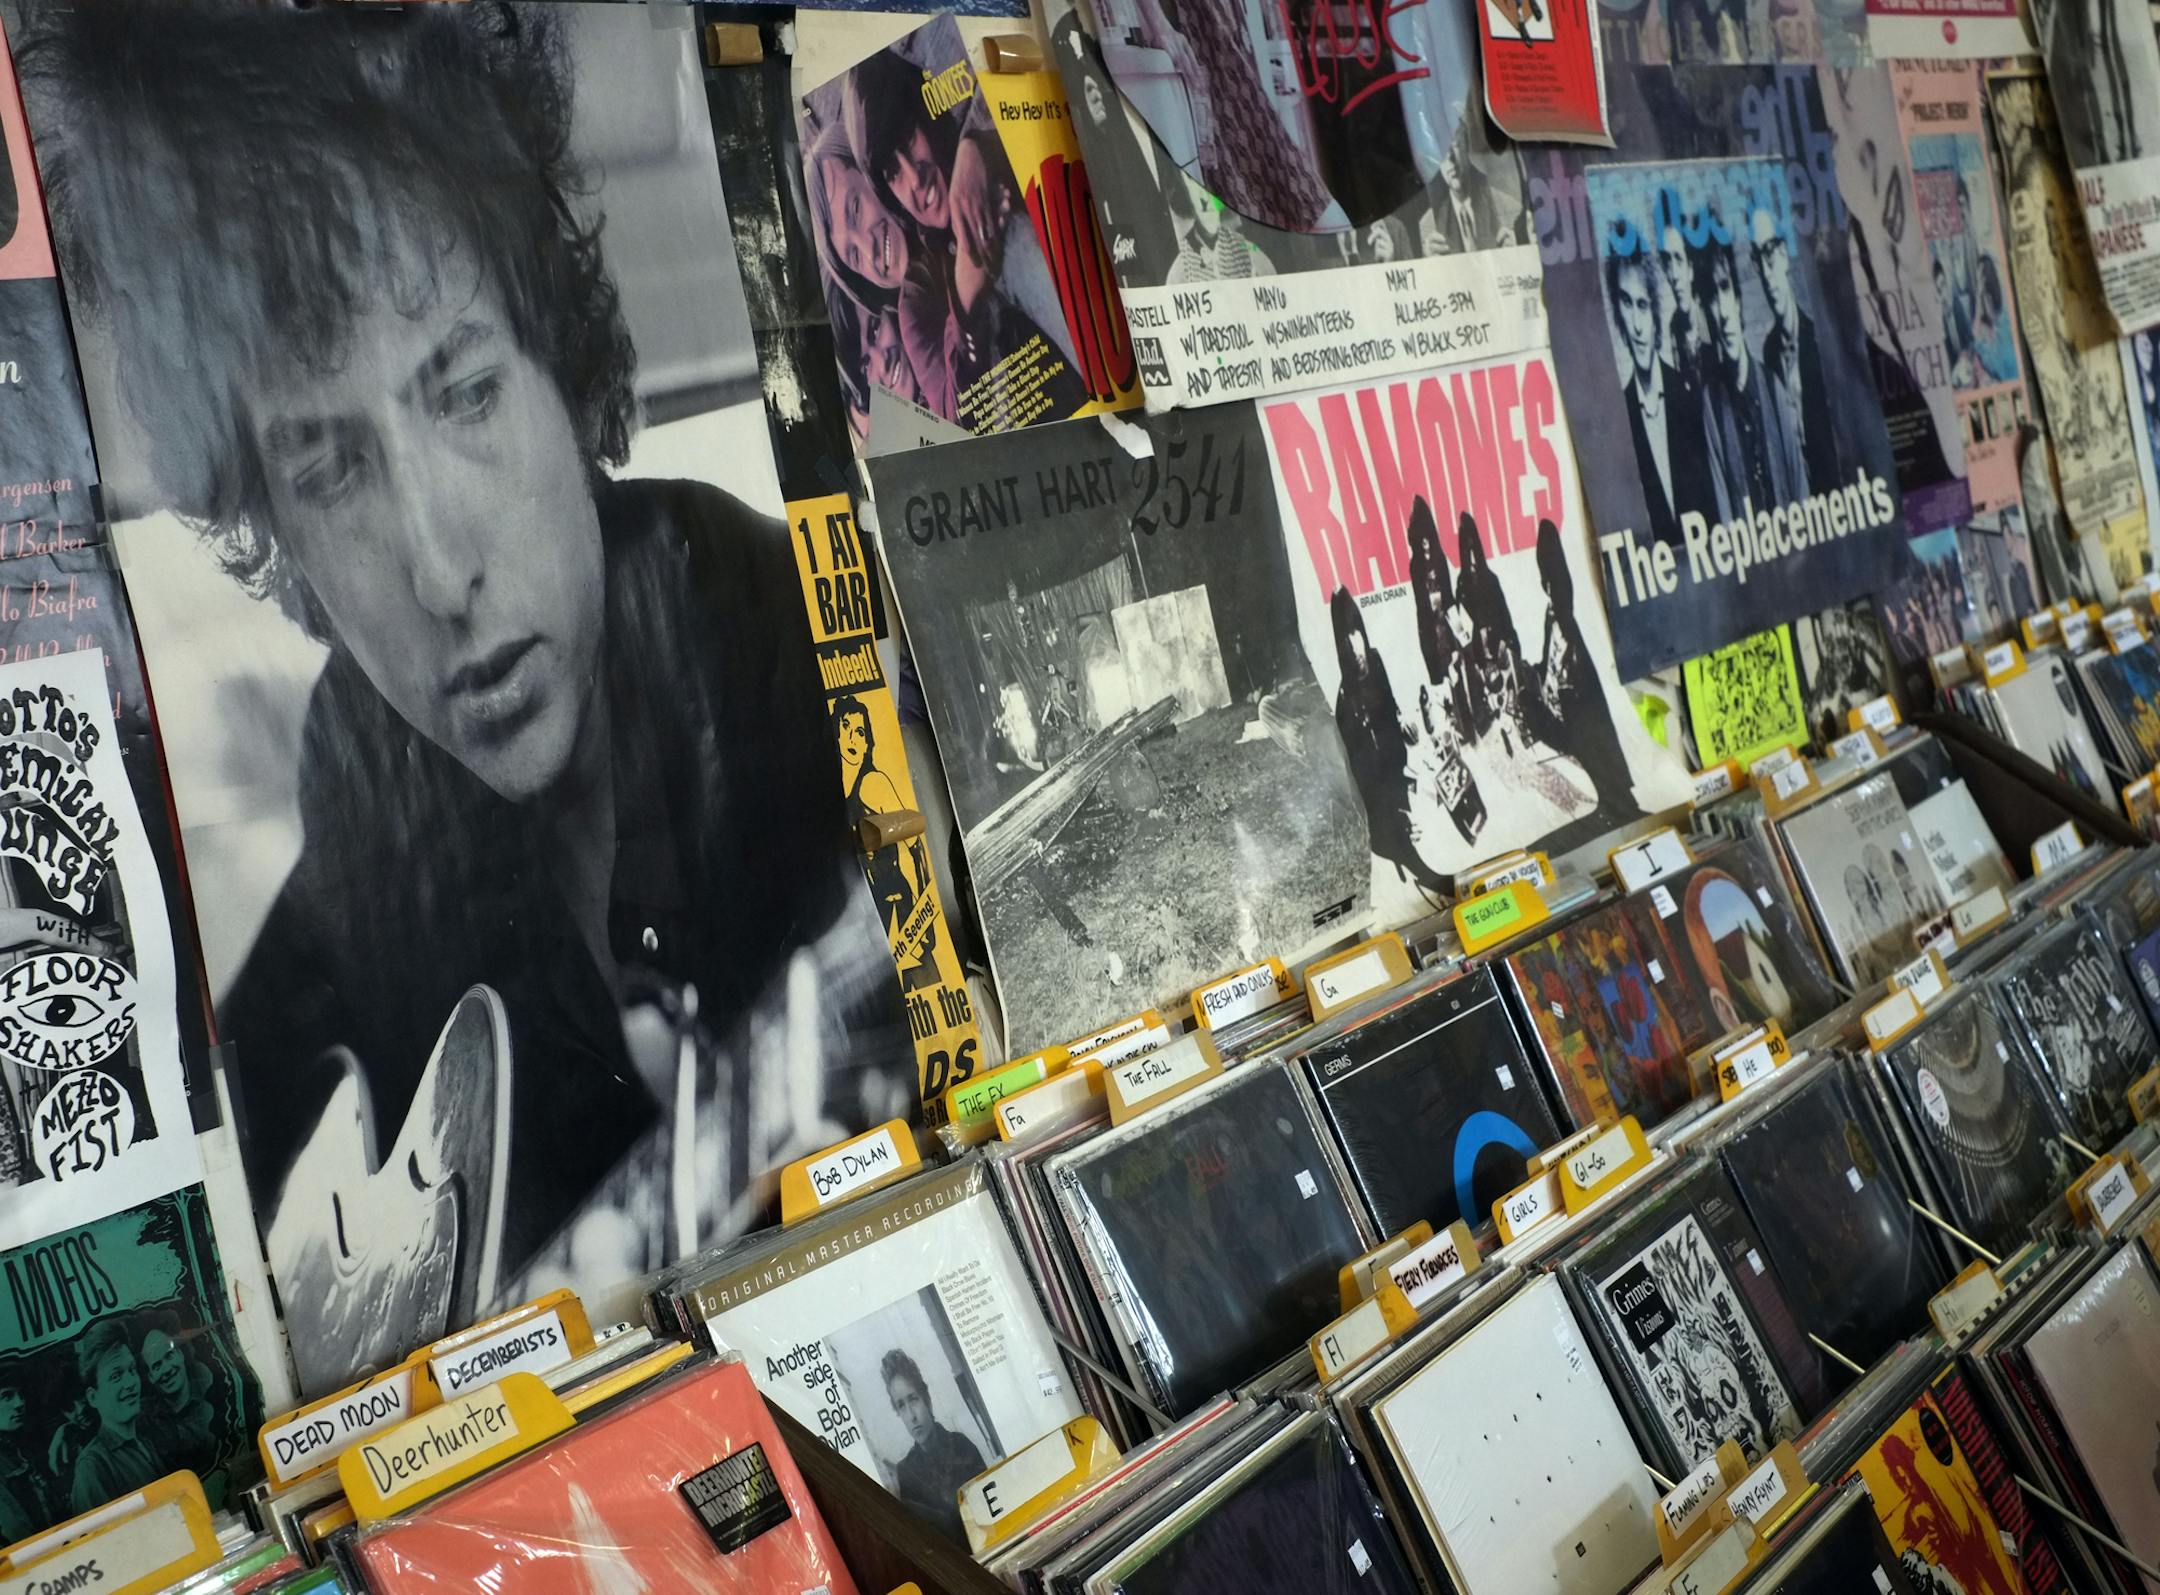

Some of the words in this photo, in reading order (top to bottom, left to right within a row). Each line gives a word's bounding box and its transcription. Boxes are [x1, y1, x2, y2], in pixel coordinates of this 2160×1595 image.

[1000, 101, 1019, 121] Hey
[1023, 101, 1043, 121] Hey
[1187, 368, 1213, 399] AND
[1271, 357, 1292, 383] AND
[914, 407, 940, 423] STEREO
[904, 476, 1022, 547] GRANT
[1036, 457, 1118, 518] HART
[1131, 433, 1246, 536] 2541
[1263, 359, 1564, 605] RAMONES
[16, 519, 86, 559] Barker
[798, 518, 819, 574] 1
[825, 512, 859, 571] AT
[1601, 528, 1678, 607] The
[1680, 466, 1895, 584] Replacements
[28, 576, 98, 622] Biafra
[814, 571, 871, 637] BAR
[1360, 593, 1383, 608] BRAIN
[1383, 586, 1407, 604] DRAIN
[817, 643, 880, 691] Indeed!
[904, 894, 935, 941] Seeing!
[0, 955, 126, 1001] FLOOR
[1203, 991, 1235, 1016] FRESH
[1248, 964, 1274, 995] ONLYS
[937, 985, 972, 1030] the
[0, 1002, 137, 1069] SHAKERS
[1124, 1069, 1144, 1089] THE
[1141, 1059, 1172, 1085] FALL
[1323, 1055, 1352, 1077] GERMS
[41, 1072, 121, 1139] MEZZO
[959, 1094, 988, 1119] THE
[1005, 1107, 1027, 1131] Fa
[50, 1107, 120, 1181] FIST
[842, 1141, 889, 1179] DYLAN
[1511, 1195, 1538, 1223] GIRLS
[4, 1230, 119, 1342] MOFOS
[707, 1257, 797, 1314] ORIGINAL
[805, 1225, 876, 1269] MASTER
[1393, 1267, 1423, 1295] FIERY
[1421, 1245, 1460, 1281] FURNACES
[1612, 1275, 1656, 1317] Grimes
[1634, 1310, 1664, 1339] Visions
[447, 1326, 559, 1391] DECEMBERISTS
[766, 1337, 824, 1382] Another
[804, 1364, 835, 1391] side
[825, 1382, 842, 1404] of
[274, 1420, 335, 1466] DEAD
[340, 1385, 402, 1433] MOON
[817, 1405, 852, 1434] Bob
[362, 1401, 510, 1495] Deerhunter
[684, 1449, 769, 1506] DEERHUNTER
[699, 1467, 779, 1528] MICROCASTLE
[982, 1480, 1004, 1518] E
[1665, 1488, 1700, 1530] FLAMING
[1698, 1471, 1716, 1497] LIPS
[1731, 1490, 1759, 1518] HENRY
[1753, 1471, 1777, 1506] FLYNT
